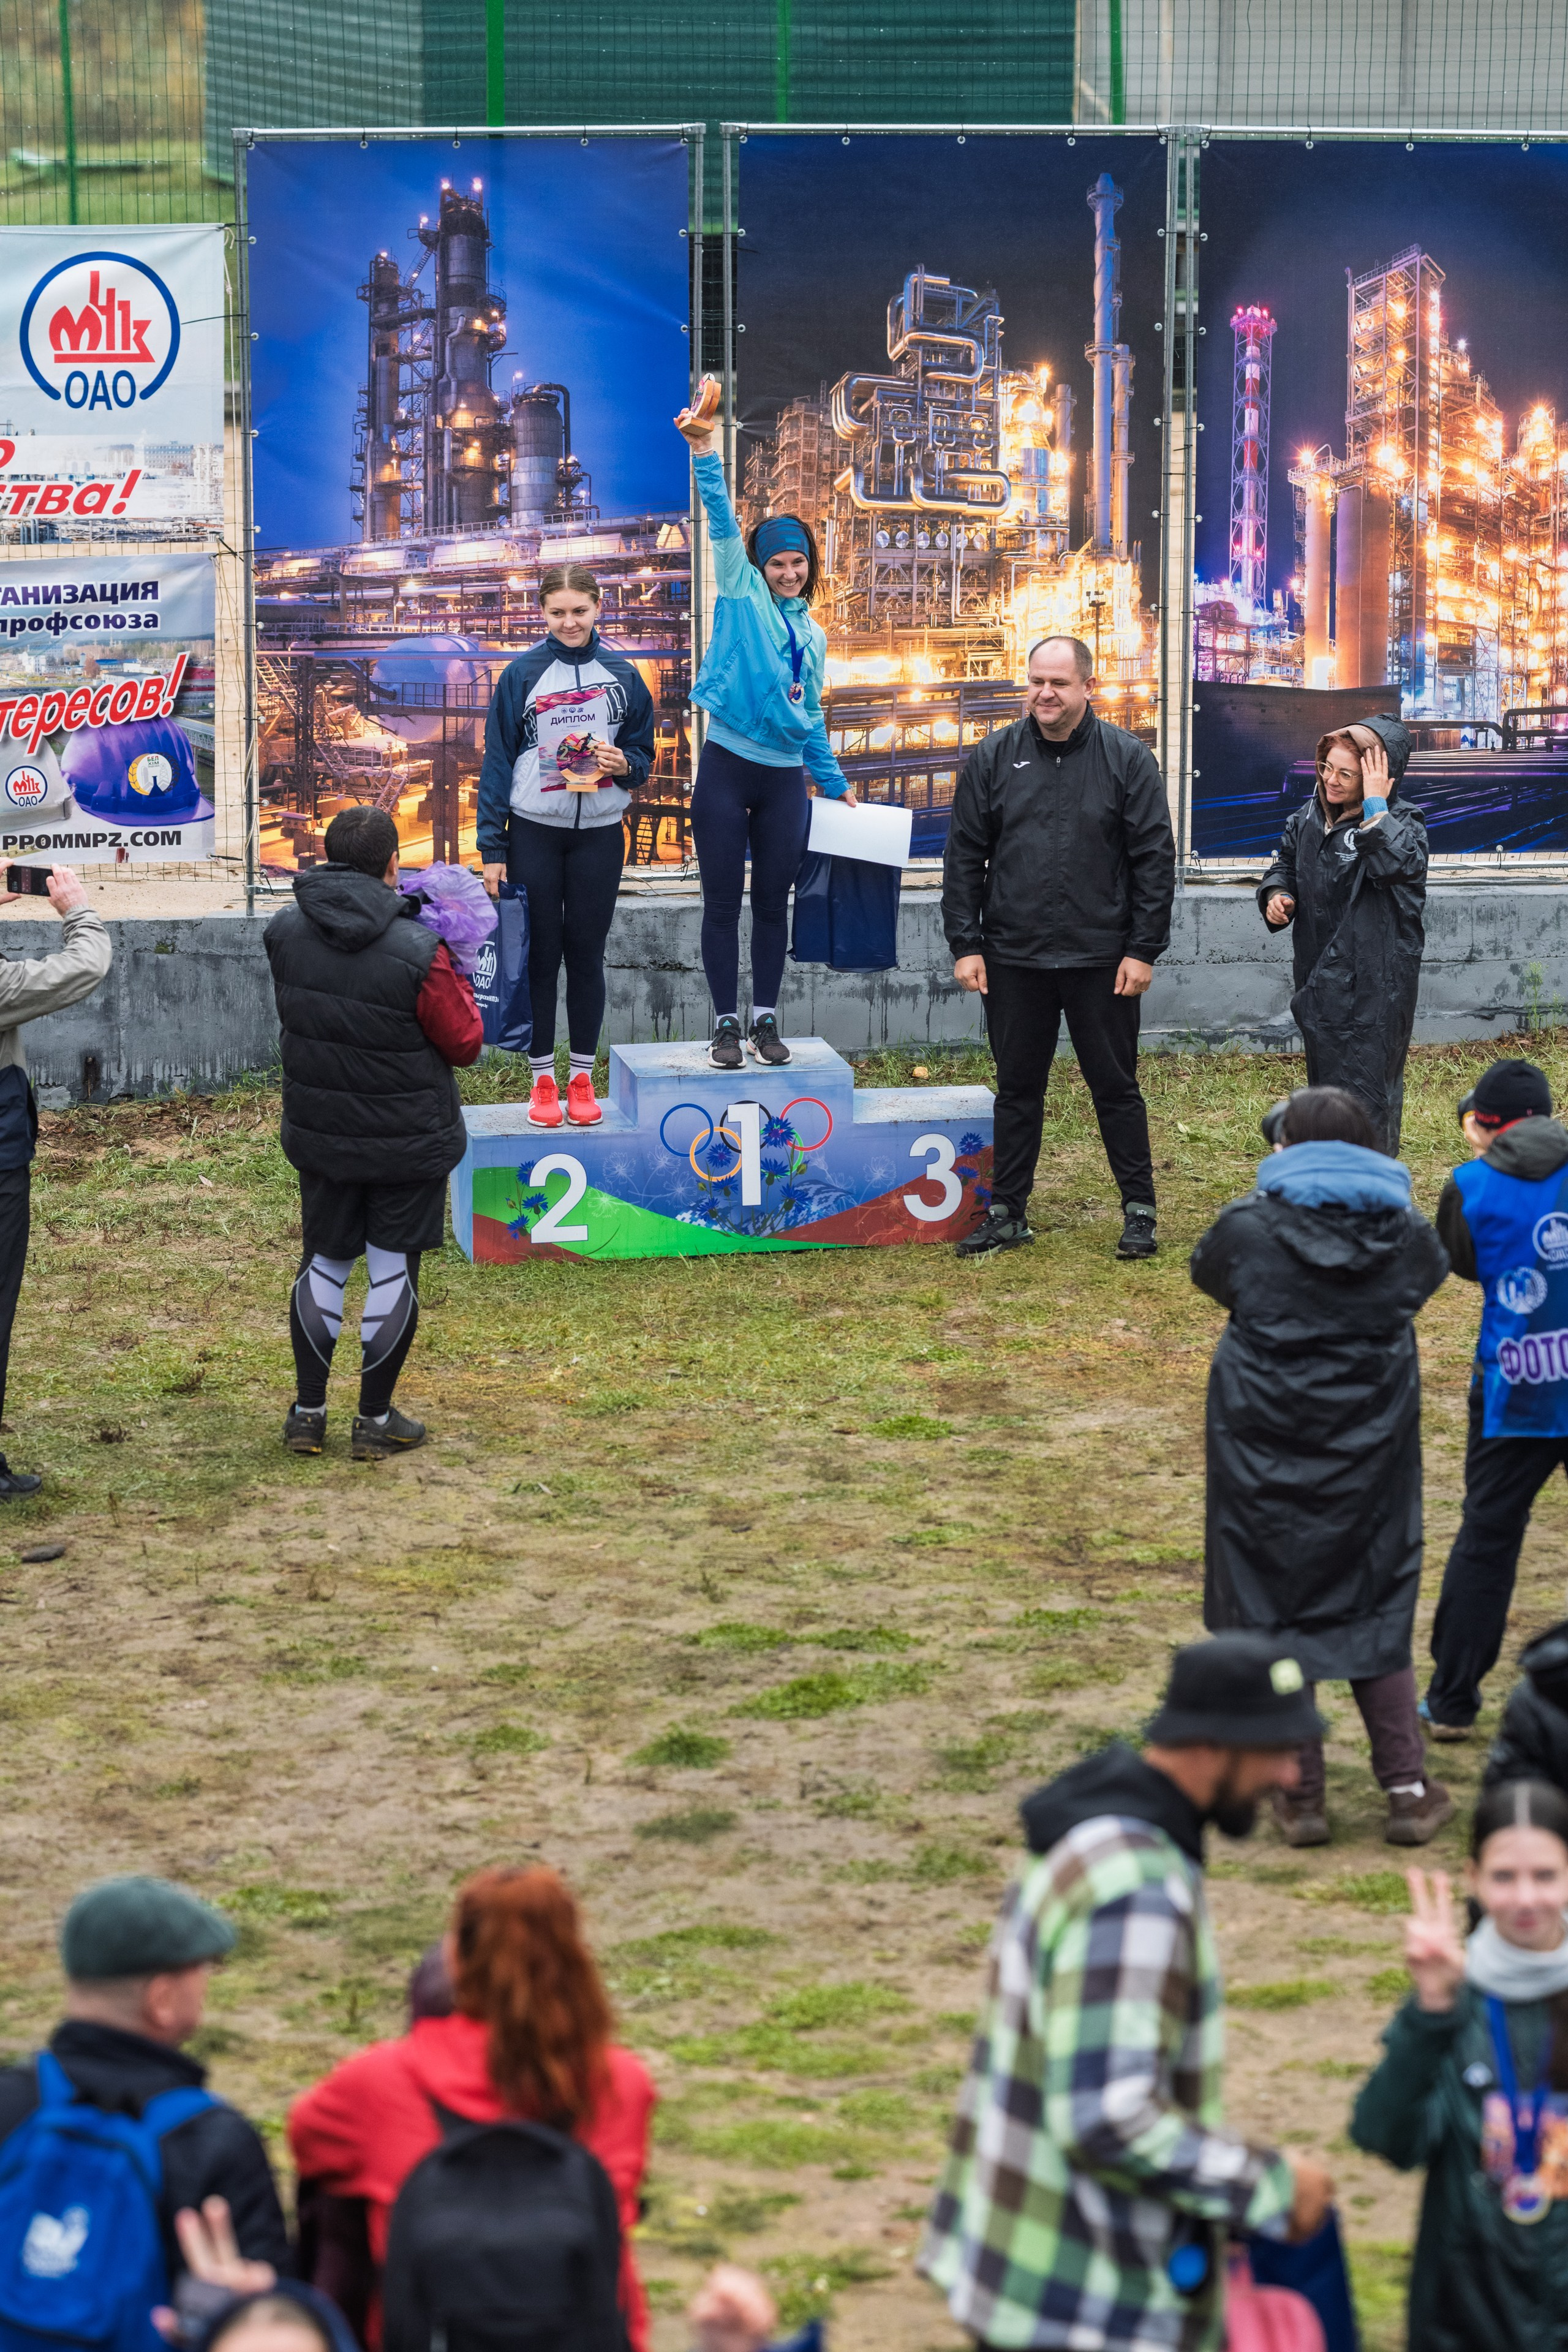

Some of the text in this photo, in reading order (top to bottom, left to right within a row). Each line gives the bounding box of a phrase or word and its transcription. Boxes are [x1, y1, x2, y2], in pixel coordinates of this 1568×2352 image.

[65, 370, 136, 410] ОАО
[0, 469, 142, 516] тва!
[0, 581, 159, 605] АНИЗАЦИЯ
[550, 713, 595, 726] ДИПЛОМ
[559, 746, 568, 760] 2
[18, 796, 37, 807] ОАО
[2, 831, 181, 850] PPOMNPZ.COM
[475, 974, 491, 989] ОАО
[726, 1102, 761, 1206] 1
[903, 1133, 963, 1222] 3
[529, 1153, 588, 1243] 2
